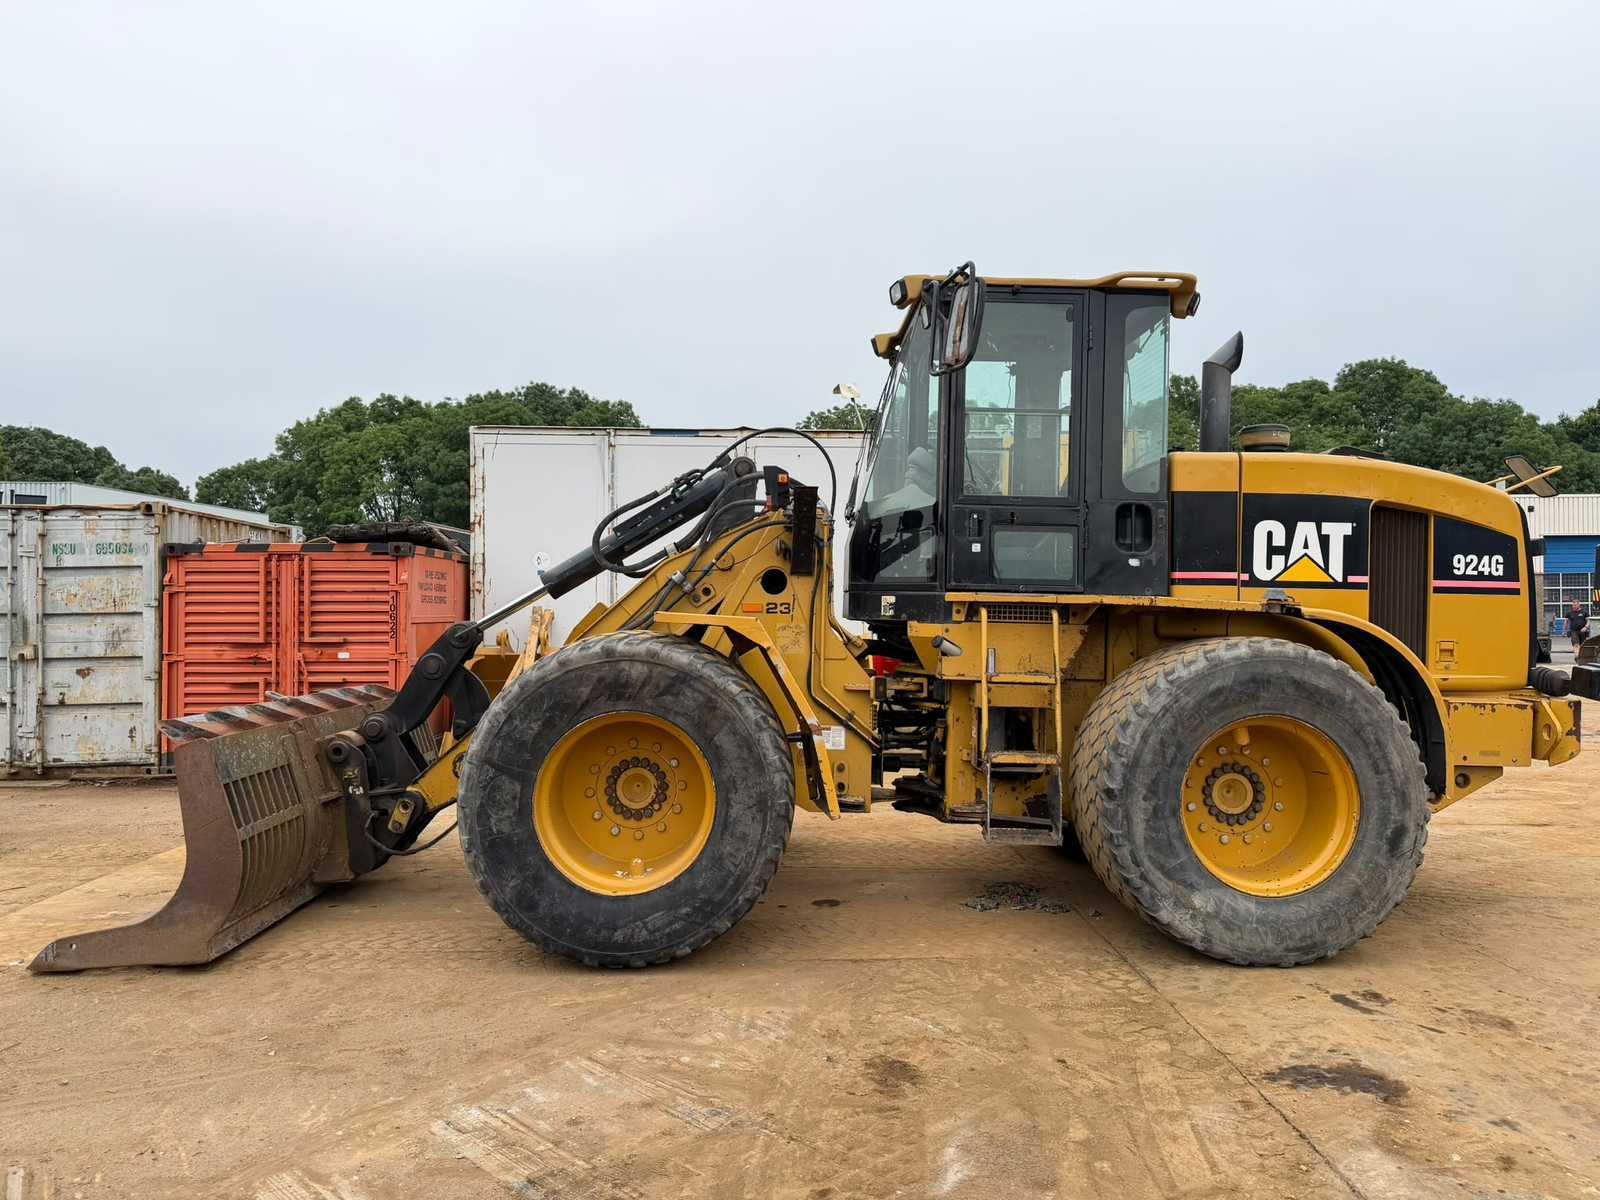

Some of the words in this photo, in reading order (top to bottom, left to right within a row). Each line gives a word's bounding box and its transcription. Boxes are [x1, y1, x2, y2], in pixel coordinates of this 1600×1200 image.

[1252, 519, 1353, 583] CAT
[1452, 553, 1504, 577] 924G
[766, 602, 791, 614] 23
